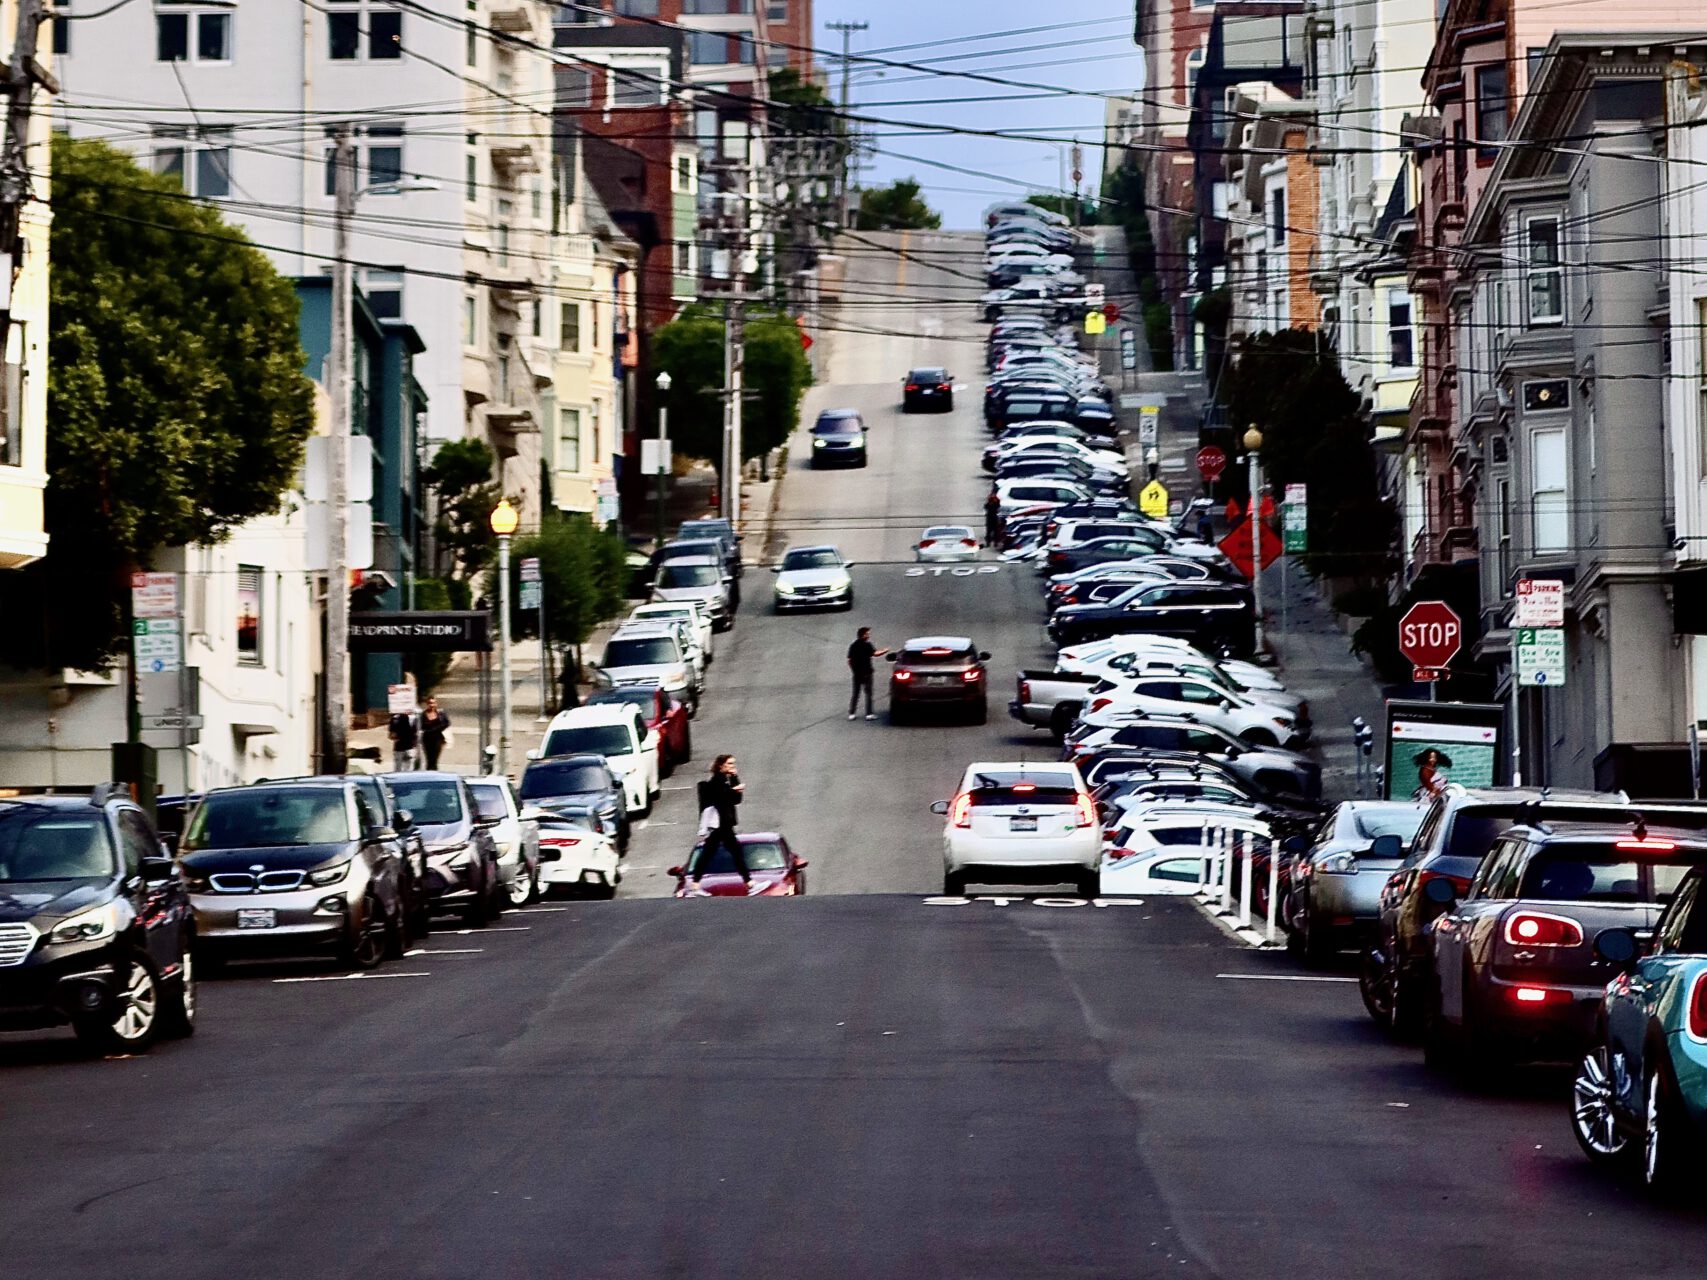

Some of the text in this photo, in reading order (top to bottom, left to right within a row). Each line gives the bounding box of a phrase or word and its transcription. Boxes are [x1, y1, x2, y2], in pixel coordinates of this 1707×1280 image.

[1197, 455, 1226, 467] STOP
[905, 565, 1001, 577] STOP
[1533, 585, 1561, 594] PARKING
[1404, 622, 1457, 648] STOP
[1521, 630, 1533, 643] 2
[922, 896, 1145, 908] STOP
